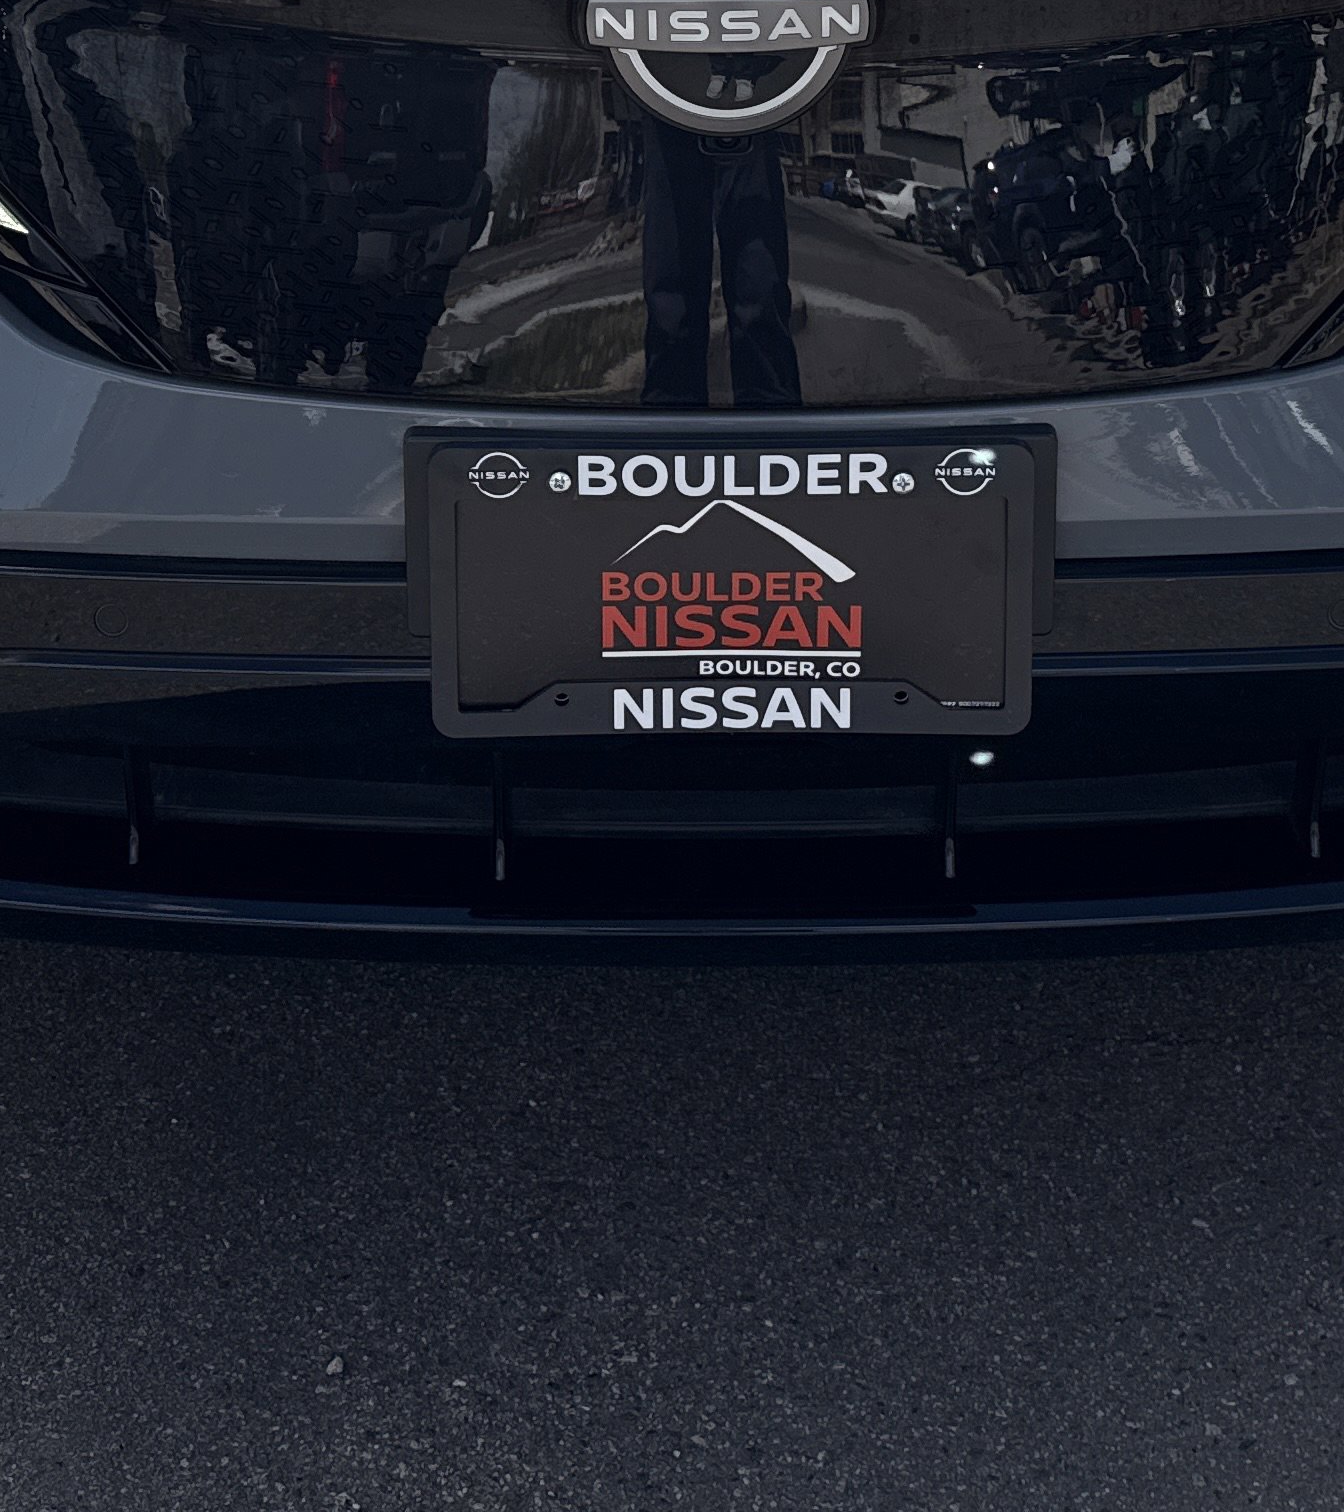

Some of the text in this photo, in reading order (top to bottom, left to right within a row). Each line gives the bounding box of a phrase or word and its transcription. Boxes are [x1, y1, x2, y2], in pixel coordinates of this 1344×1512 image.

[594, 3, 860, 43] NISSAN
[468, 471, 530, 480] NISSAN
[577, 453, 889, 497] BOULDER
[934, 467, 996, 477] NISSAN
[601, 571, 824, 601] BOULDER
[601, 604, 863, 649] NISSAN
[699, 659, 862, 679] BOULDER, CO
[613, 686, 852, 730] NISSAN
